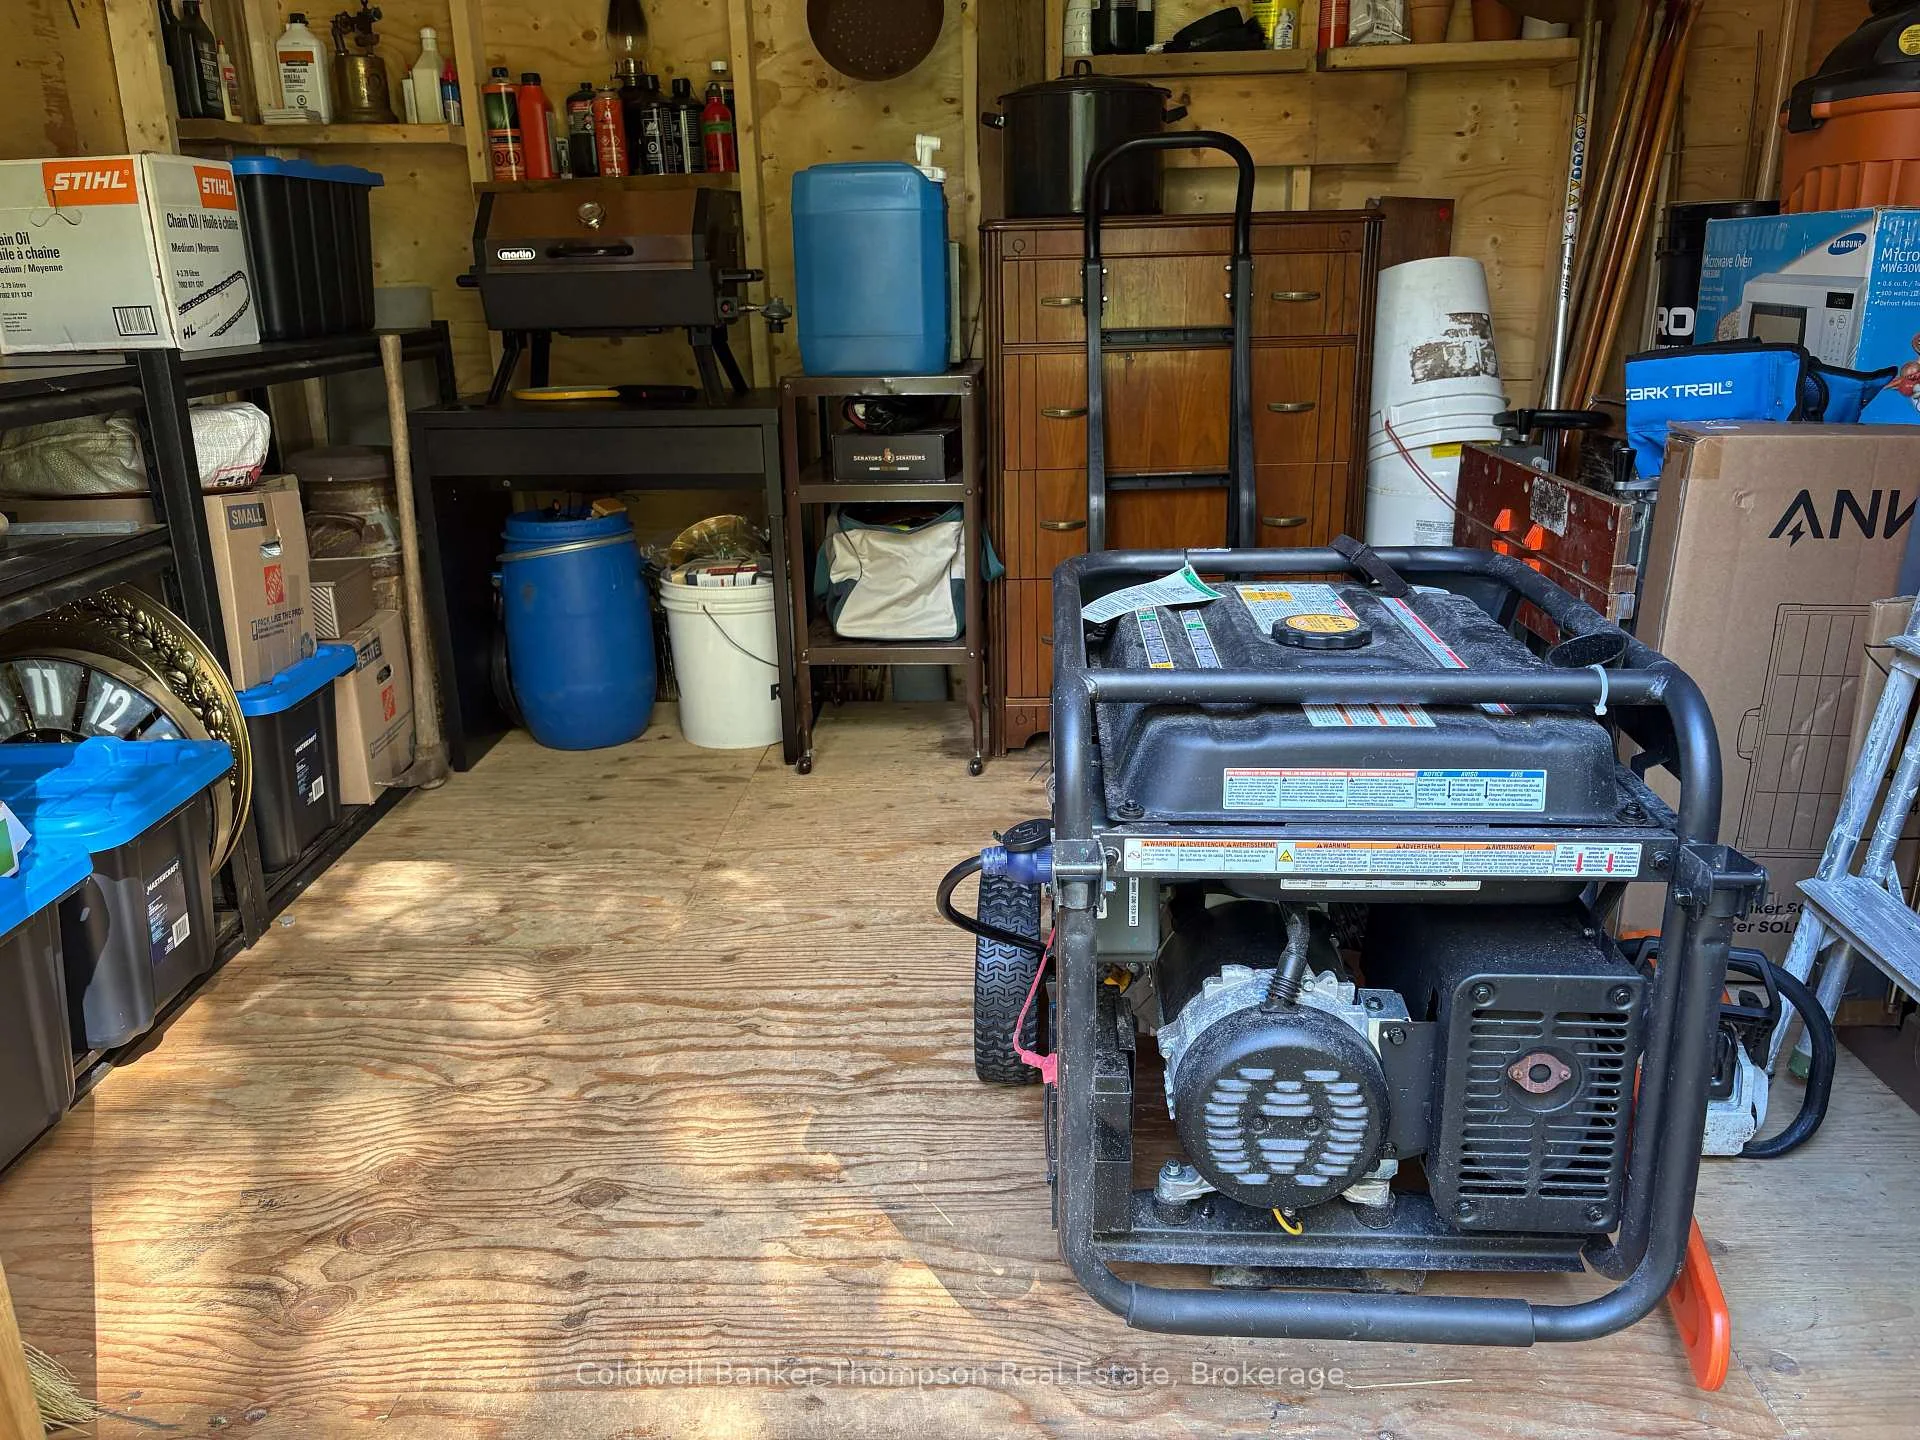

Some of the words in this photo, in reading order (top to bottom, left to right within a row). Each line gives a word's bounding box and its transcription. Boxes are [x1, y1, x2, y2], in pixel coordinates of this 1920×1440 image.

[53, 170, 128, 191] STIHL
[201, 177, 233, 196] STIHL
[166, 212, 189, 229] Chain
[189, 213, 200, 229] Oil
[15, 231, 31, 245] Oil
[1832, 239, 1862, 248] SAMSUNG
[16, 246, 24, 260] à
[25, 245, 61, 260] chaîne
[501, 249, 532, 259] martin
[1881, 247, 1920, 262] Micro
[28, 264, 64, 274] Moyenne
[1625, 386, 1670, 401] ZARK
[231, 507, 264, 526] SMALL
[26, 667, 63, 716] 11
[89, 681, 132, 734] 12
